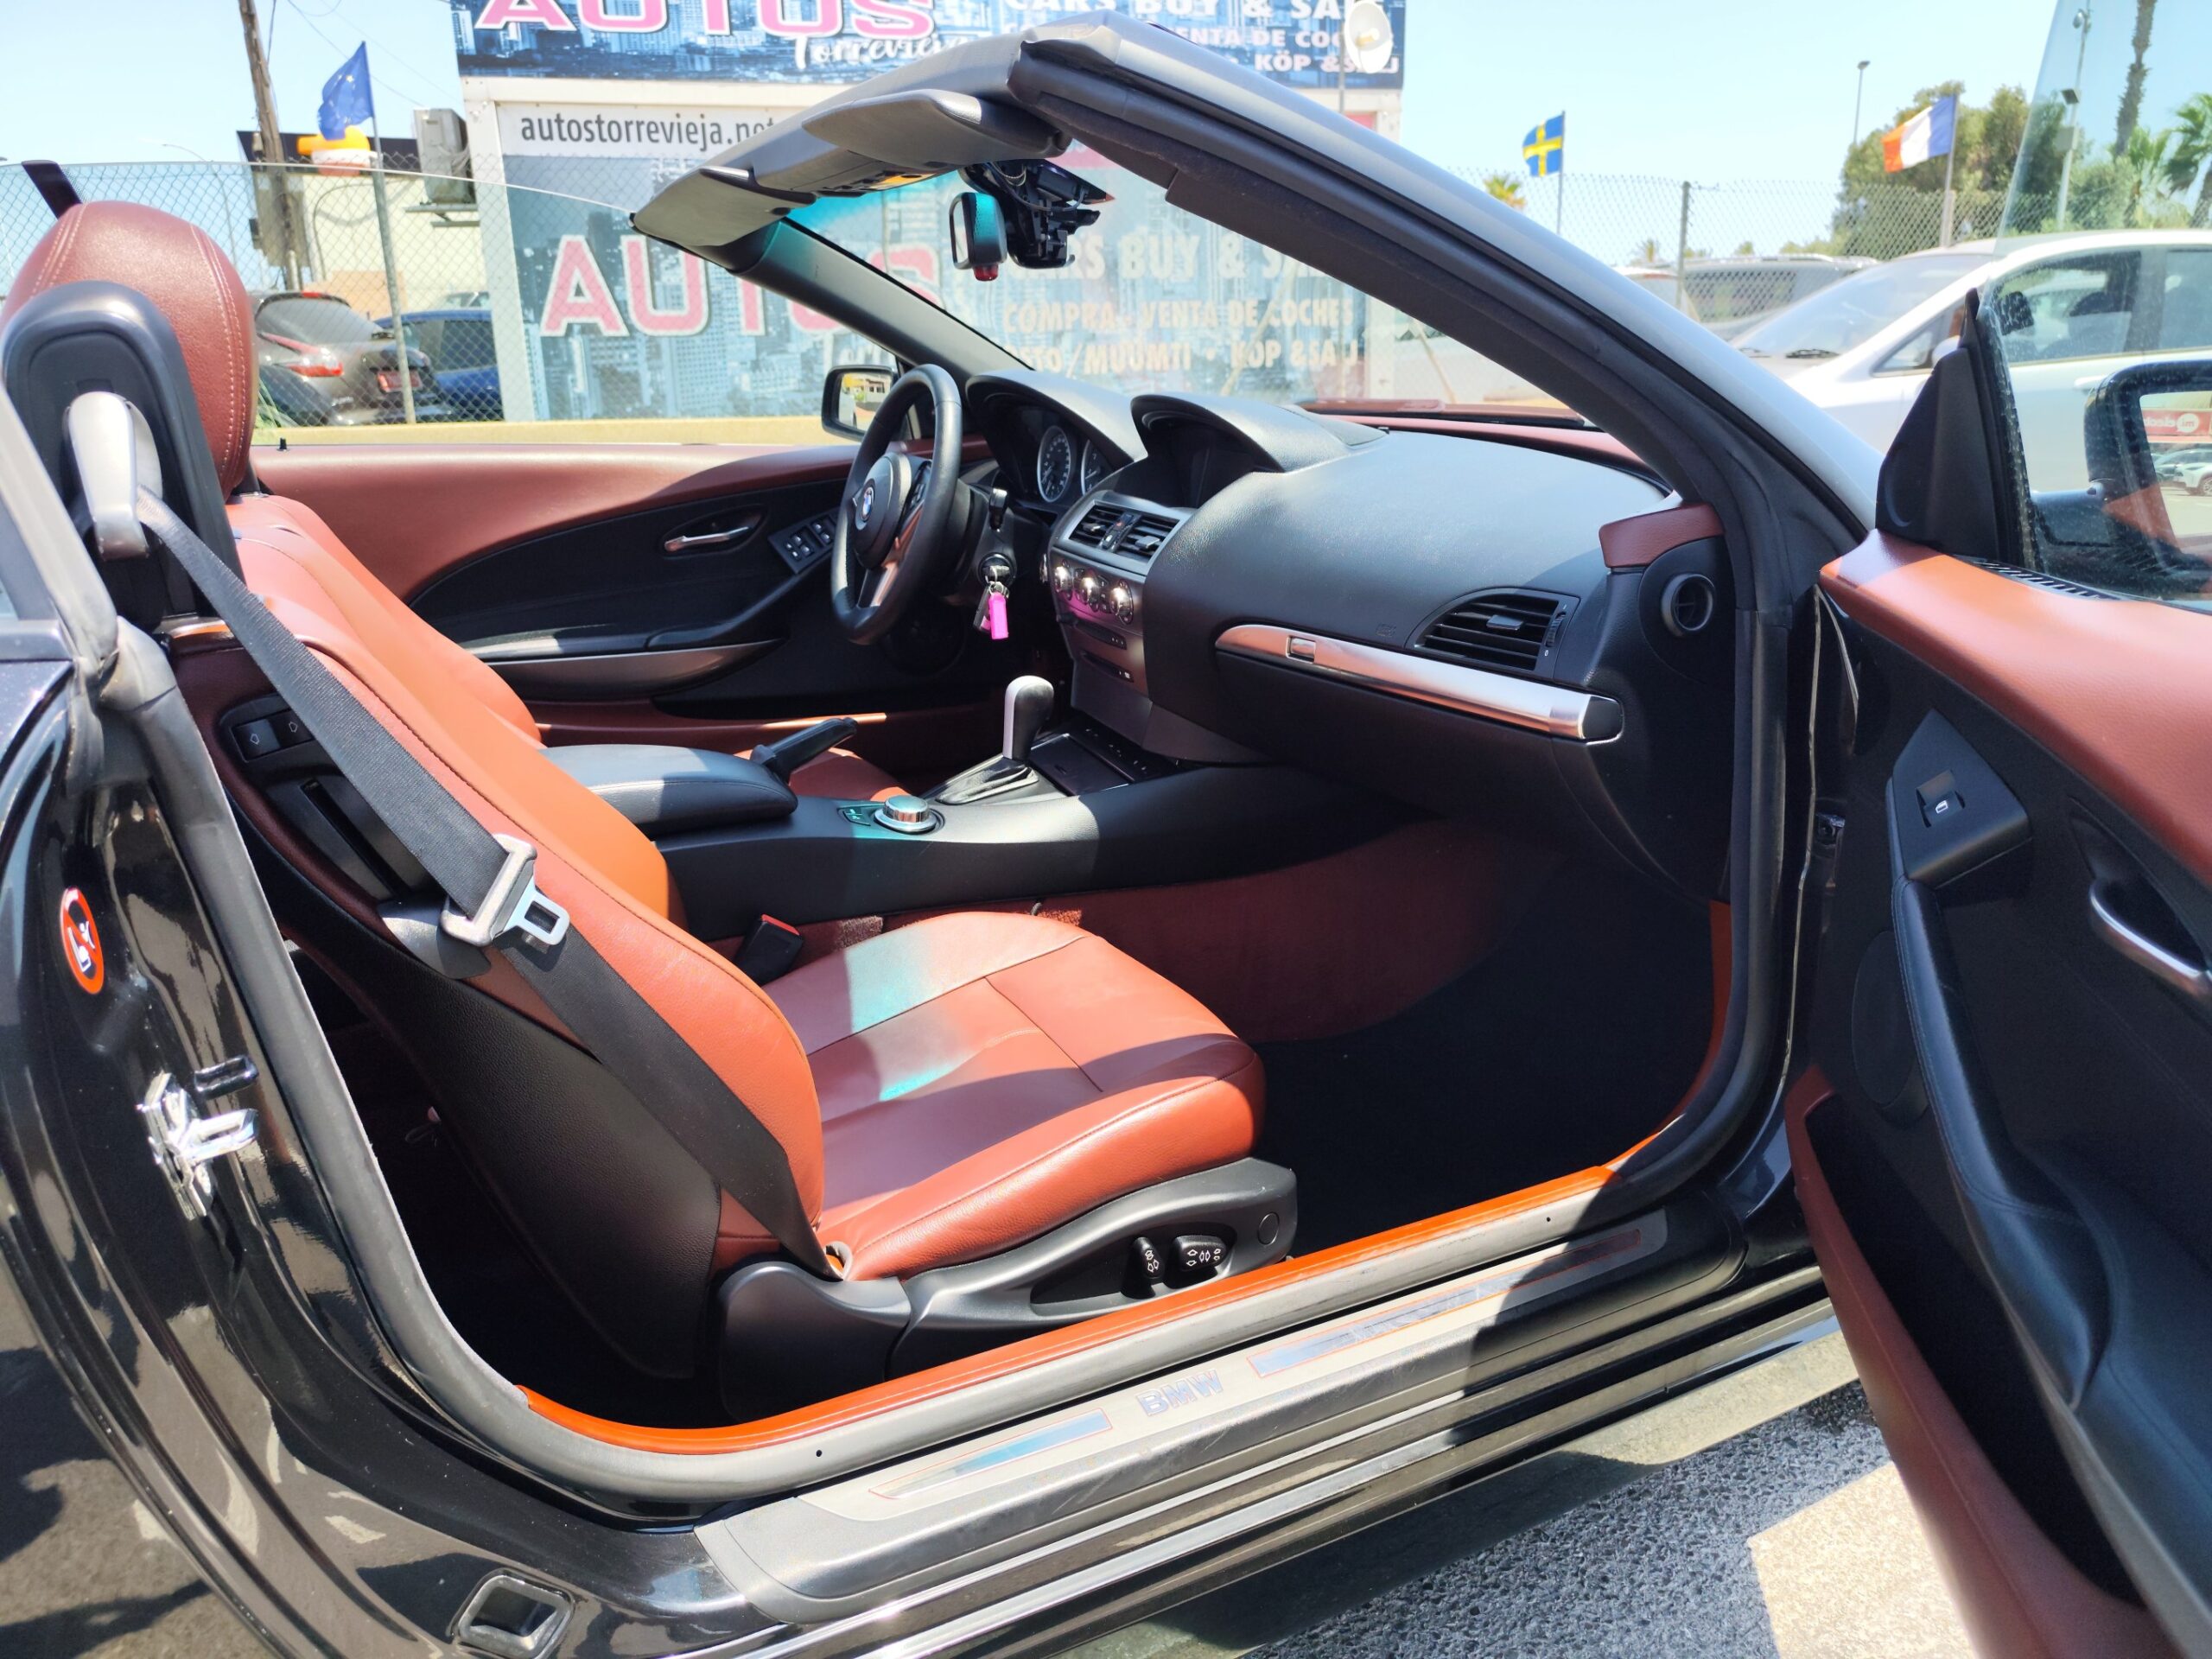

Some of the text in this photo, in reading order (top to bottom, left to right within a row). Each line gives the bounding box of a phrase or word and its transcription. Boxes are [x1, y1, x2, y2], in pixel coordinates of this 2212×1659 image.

[1172, 27, 1244, 48] ENTA
[1251, 29, 1287, 48] DE
[1255, 49, 1312, 73] KÖP
[1119, 233, 1200, 280] BUY
[1003, 297, 1354, 334] COMPRA VENTA DE COCHES
[1135, 1369, 1224, 1417] BMW
